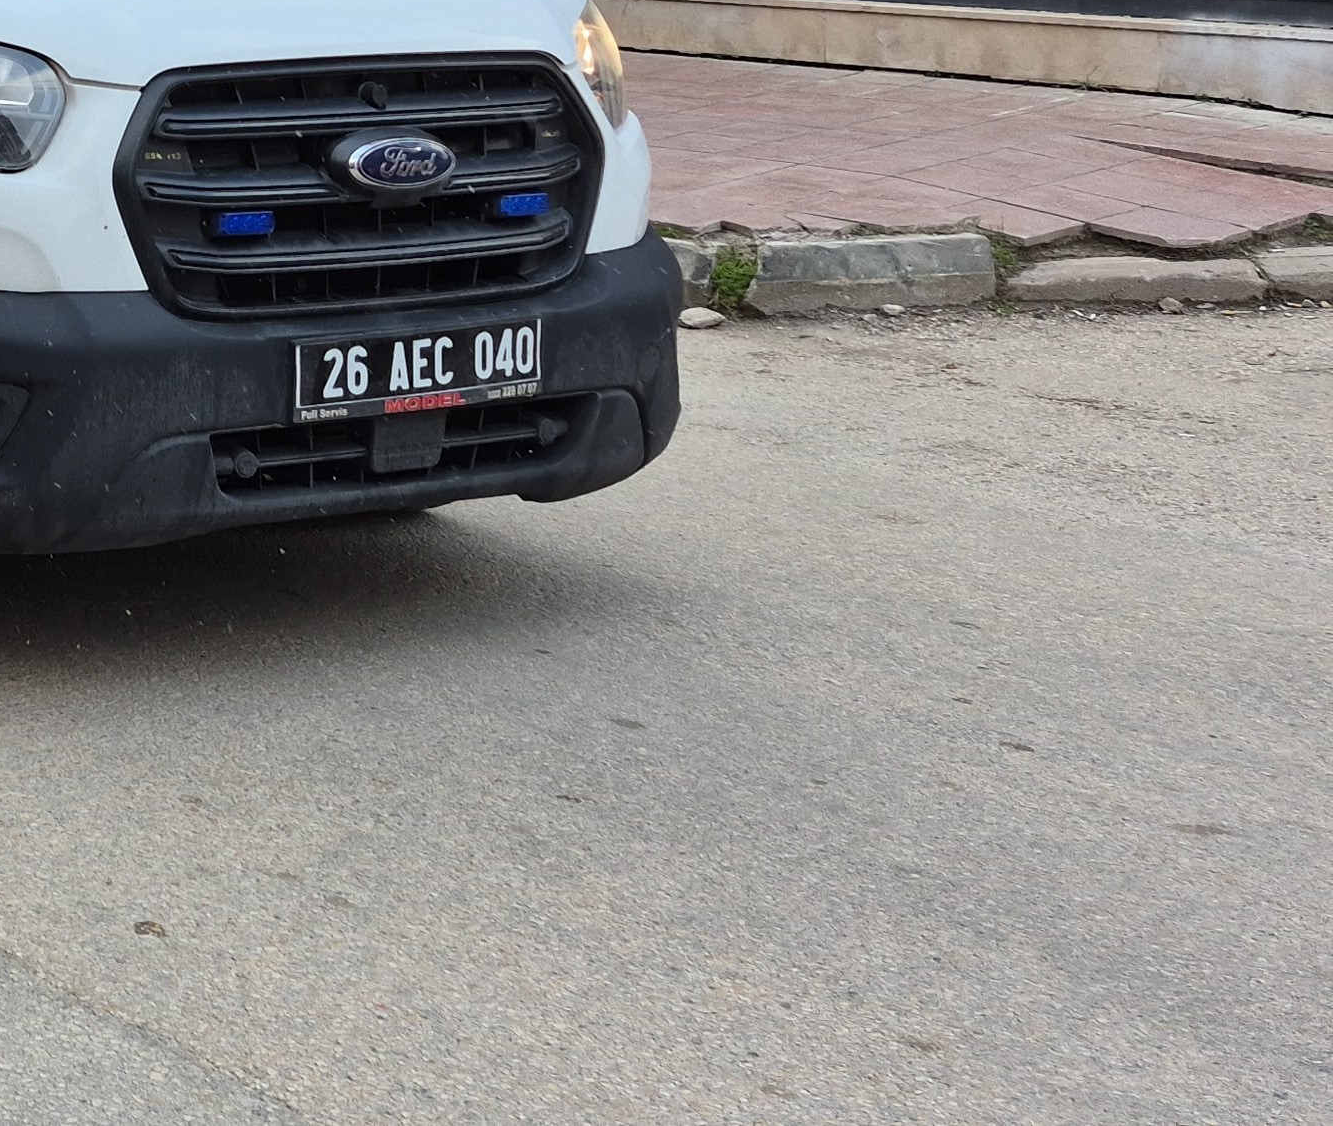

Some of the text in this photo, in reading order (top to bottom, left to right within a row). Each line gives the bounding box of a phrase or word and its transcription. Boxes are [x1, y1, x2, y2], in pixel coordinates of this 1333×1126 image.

[380, 146, 438, 178] Ford
[323, 326, 535, 399] 26 AEC 040
[385, 392, 467, 414] MODEL
